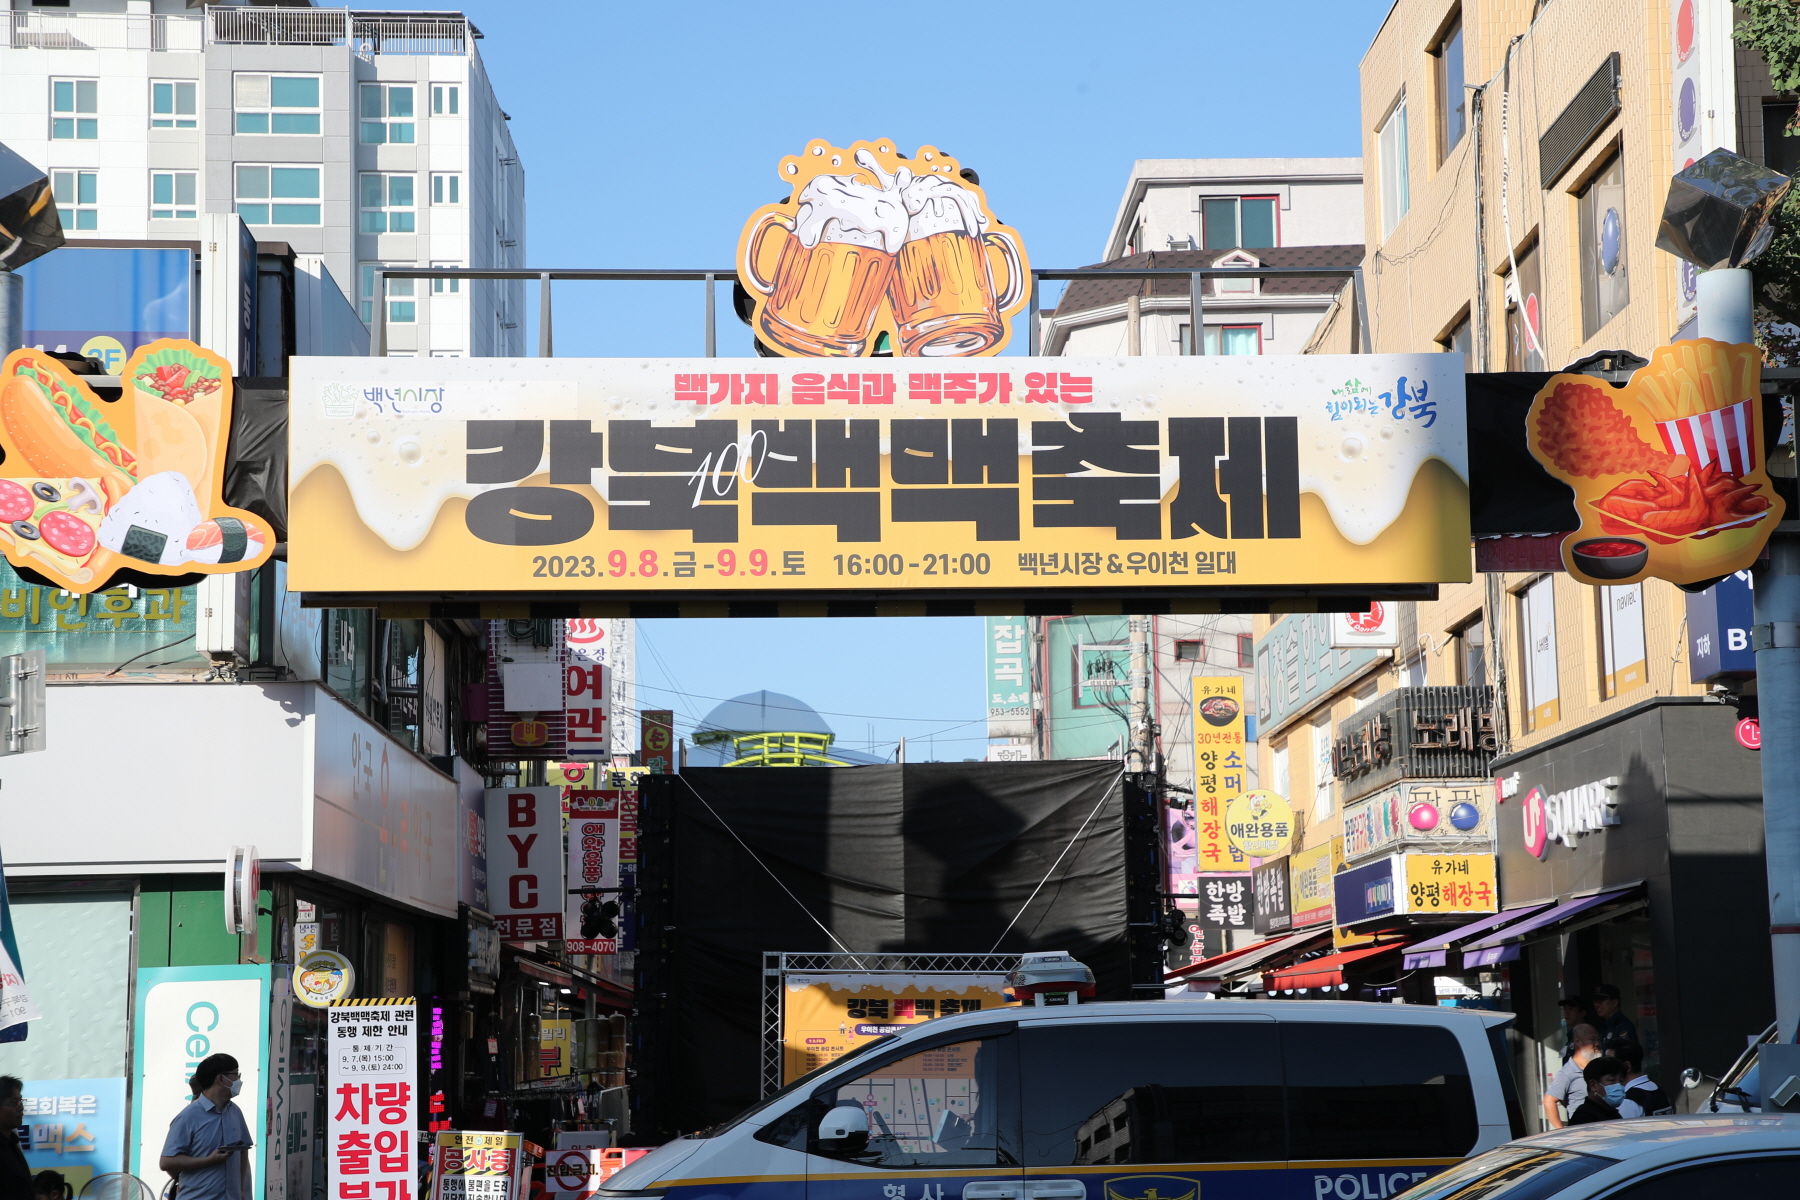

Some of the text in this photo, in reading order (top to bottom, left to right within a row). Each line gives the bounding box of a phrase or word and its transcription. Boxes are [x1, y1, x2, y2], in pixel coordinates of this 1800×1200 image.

[363, 387, 446, 413] 백년시장
[675, 371, 1093, 406] 백가지 음식과 맥주가 있는
[1377, 375, 1438, 429] 강북
[464, 411, 1302, 547] 강북백맥축제
[1194, 551, 1237, 577] 일대
[1696, 633, 1711, 657] 지하
[1727, 628, 1752, 651] B
[1272, 613, 1352, 716] 청솔한의
[1201, 685, 1236, 695] 유가네
[567, 664, 607, 743] 여관
[990, 707, 1030, 717] 953-5552
[525, 722, 535, 735] B1
[1197, 732, 1243, 745] 30년전통
[1546, 775, 1621, 848] SQUARE
[1230, 822, 1290, 839] 애완용품
[506, 793, 539, 910] BYC
[1431, 859, 1470, 876] 유가네
[1205, 880, 1246, 903] 한방
[1206, 903, 1247, 926] 족발
[493, 915, 557, 939] 전문점
[566, 940, 616, 953] 908-4070
[330, 1009, 415, 1024] 강북백맥축제 관련
[337, 1025, 408, 1039] 통행 제한 안내
[374, 1054, 395, 1062] 15:00
[382, 1063, 404, 1071] 24:00
[334, 1082, 411, 1126] 차량
[336, 1130, 409, 1176] 출입
[444, 1148, 511, 1173] 공사중
[443, 1178, 466, 1192] 통행에
[1313, 1172, 1428, 1200] POLIC
